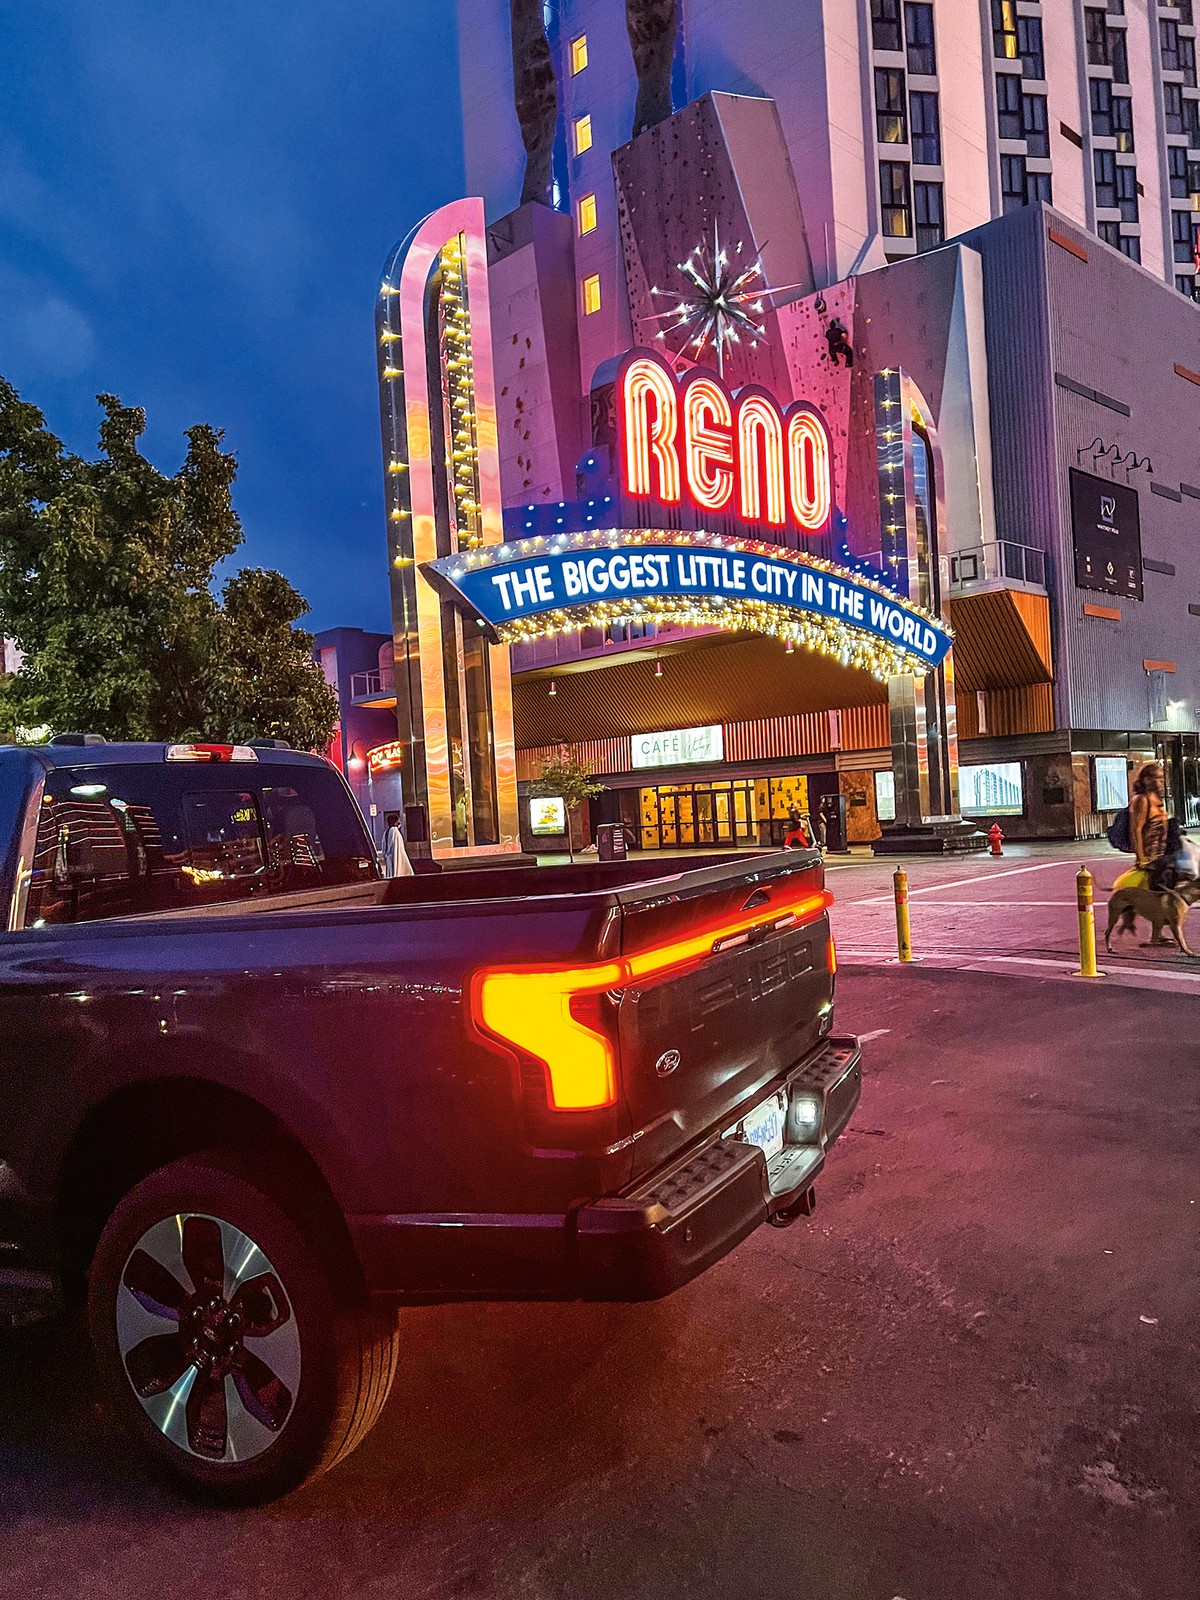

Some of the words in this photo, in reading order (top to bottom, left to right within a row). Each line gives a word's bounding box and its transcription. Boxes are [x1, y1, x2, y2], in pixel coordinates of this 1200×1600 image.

[624, 358, 831, 530] RENO
[491, 564, 554, 611] THE
[561, 554, 671, 597] BIGGEST
[677, 554, 746, 590] LITTLE
[751, 562, 797, 598] CITY
[801, 573, 824, 606] IN
[828, 581, 864, 620] THE
[870, 597, 937, 656] WORLD
[640, 735, 679, 755] CAFÉ
